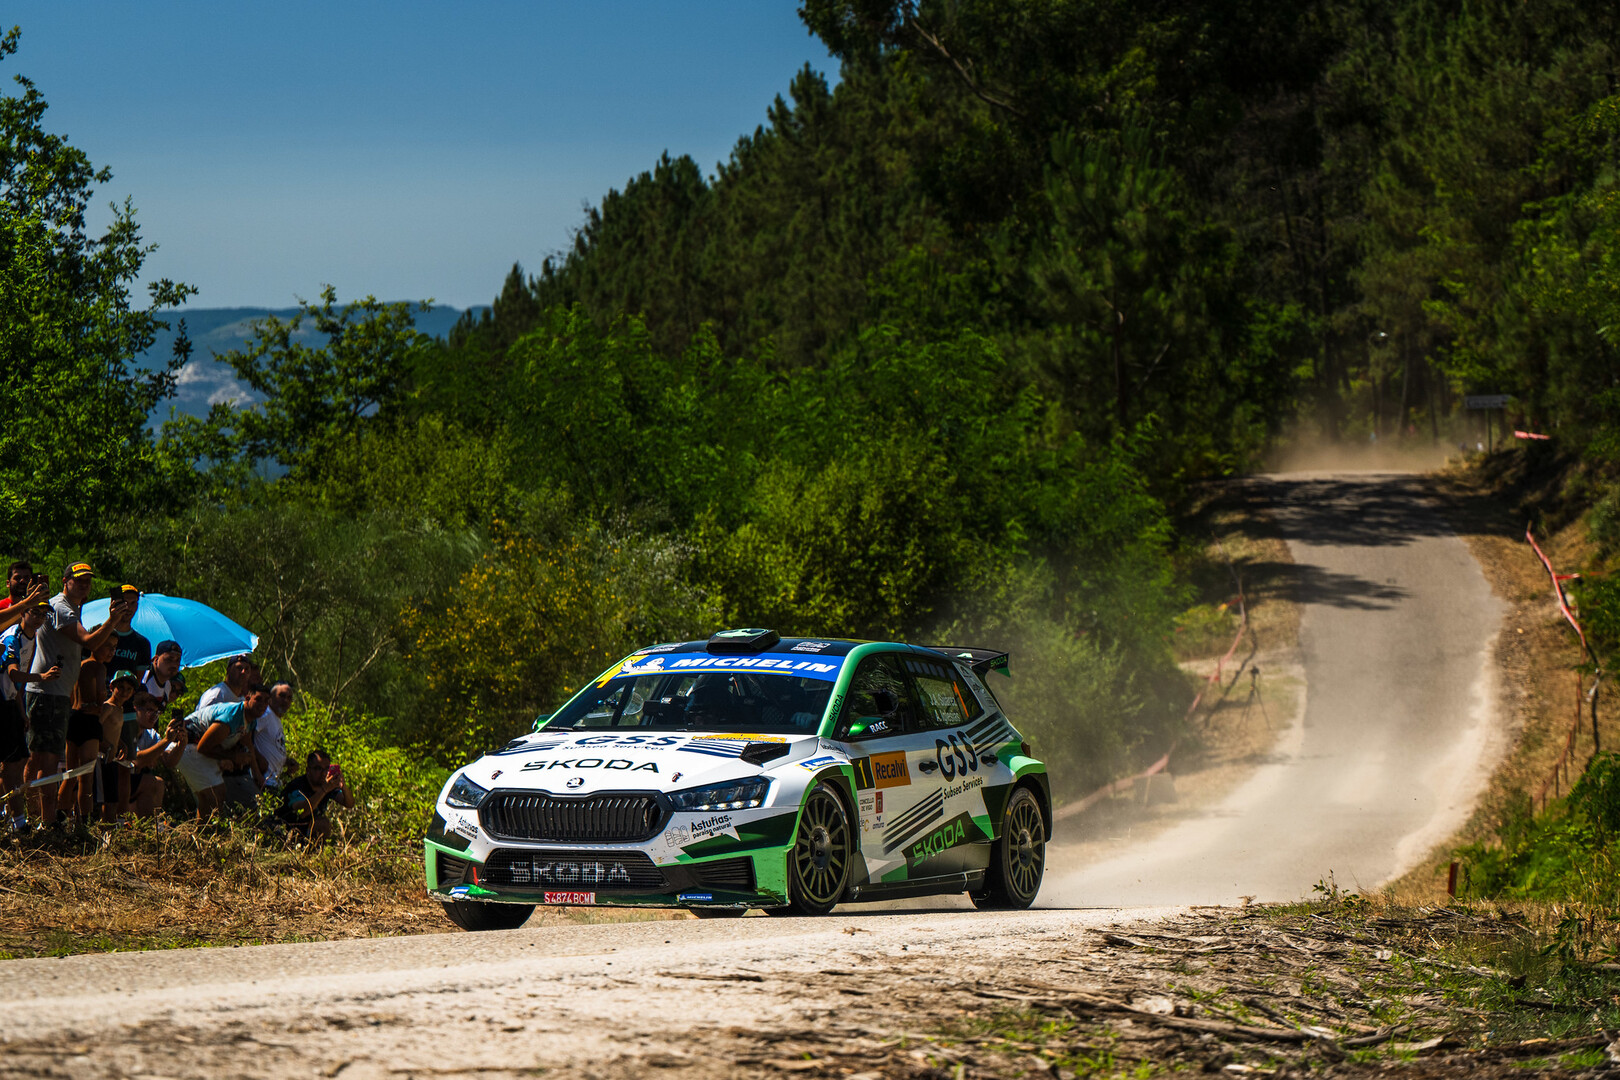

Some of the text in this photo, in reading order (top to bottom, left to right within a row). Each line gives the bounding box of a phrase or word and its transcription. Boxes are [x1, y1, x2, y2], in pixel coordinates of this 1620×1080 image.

[115, 648, 138, 661] calvi
[669, 657, 837, 673] MICHELIN
[829, 694, 844, 723] SKODA
[869, 721, 888, 733] RACC
[575, 735, 686, 746] GSS
[519, 758, 659, 773] SKODA
[935, 730, 978, 782] GSS
[858, 760, 868, 788] 1
[875, 759, 906, 780] Recalvi
[943, 776, 983, 800] Subsea Services
[712, 821, 732, 833] natural
[912, 818, 966, 868] SKODA
[510, 861, 631, 882] SKODA
